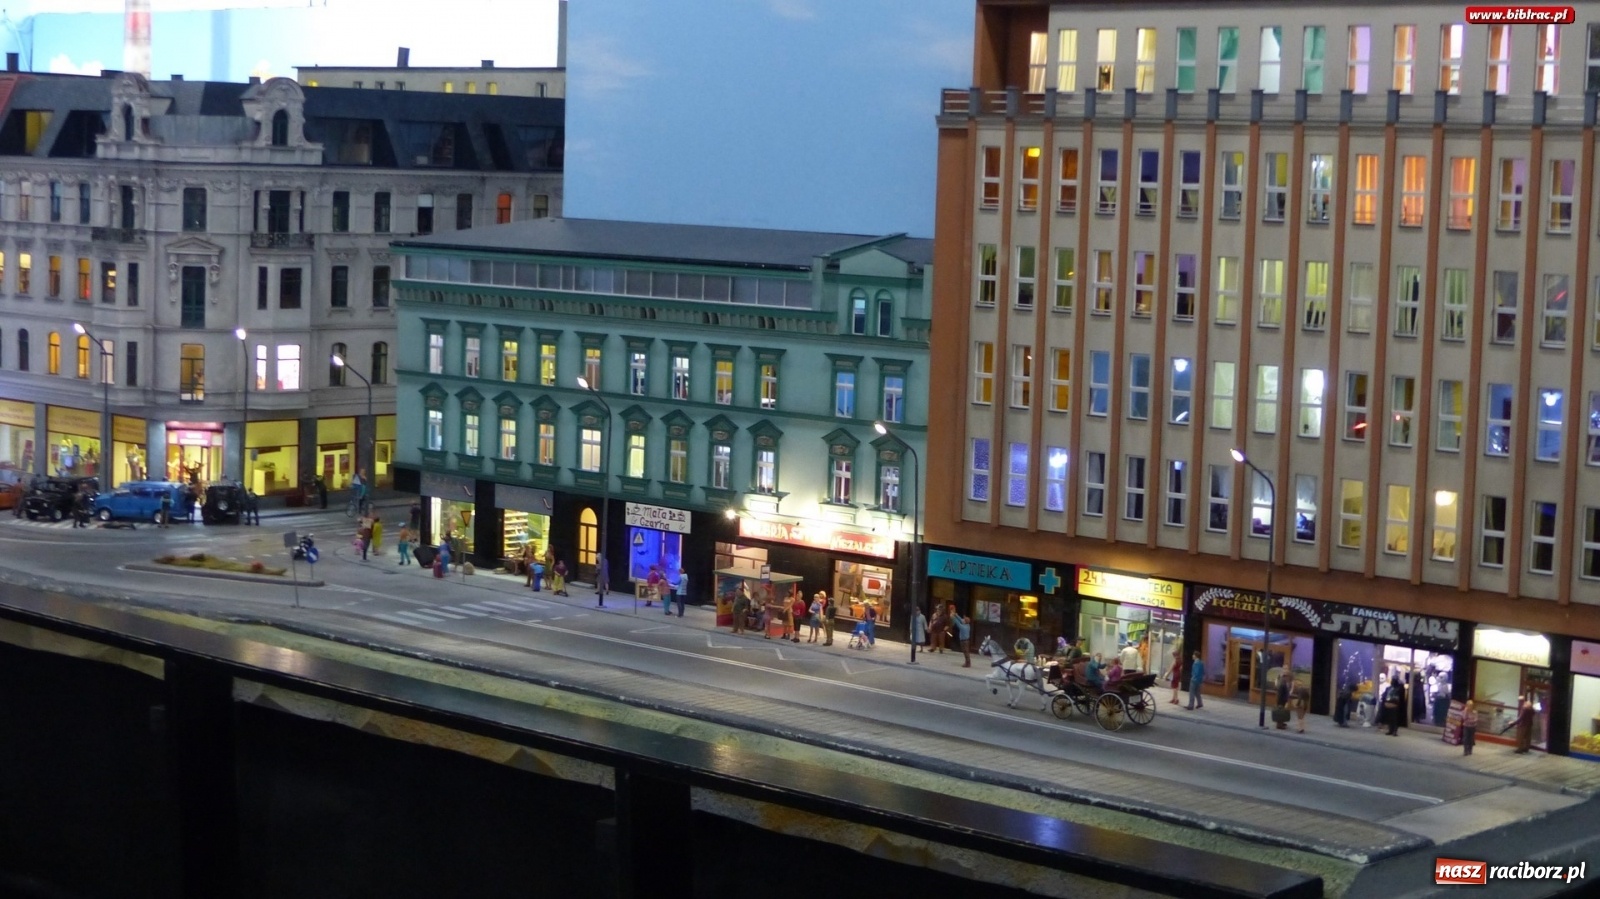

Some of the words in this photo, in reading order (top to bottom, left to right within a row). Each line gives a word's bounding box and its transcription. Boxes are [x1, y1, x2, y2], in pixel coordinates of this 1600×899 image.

[942, 558, 1013, 581] APTEKA
[1083, 570, 1097, 583] 24
[1321, 613, 1399, 640] STAR
[1396, 613, 1460, 640] WARS
